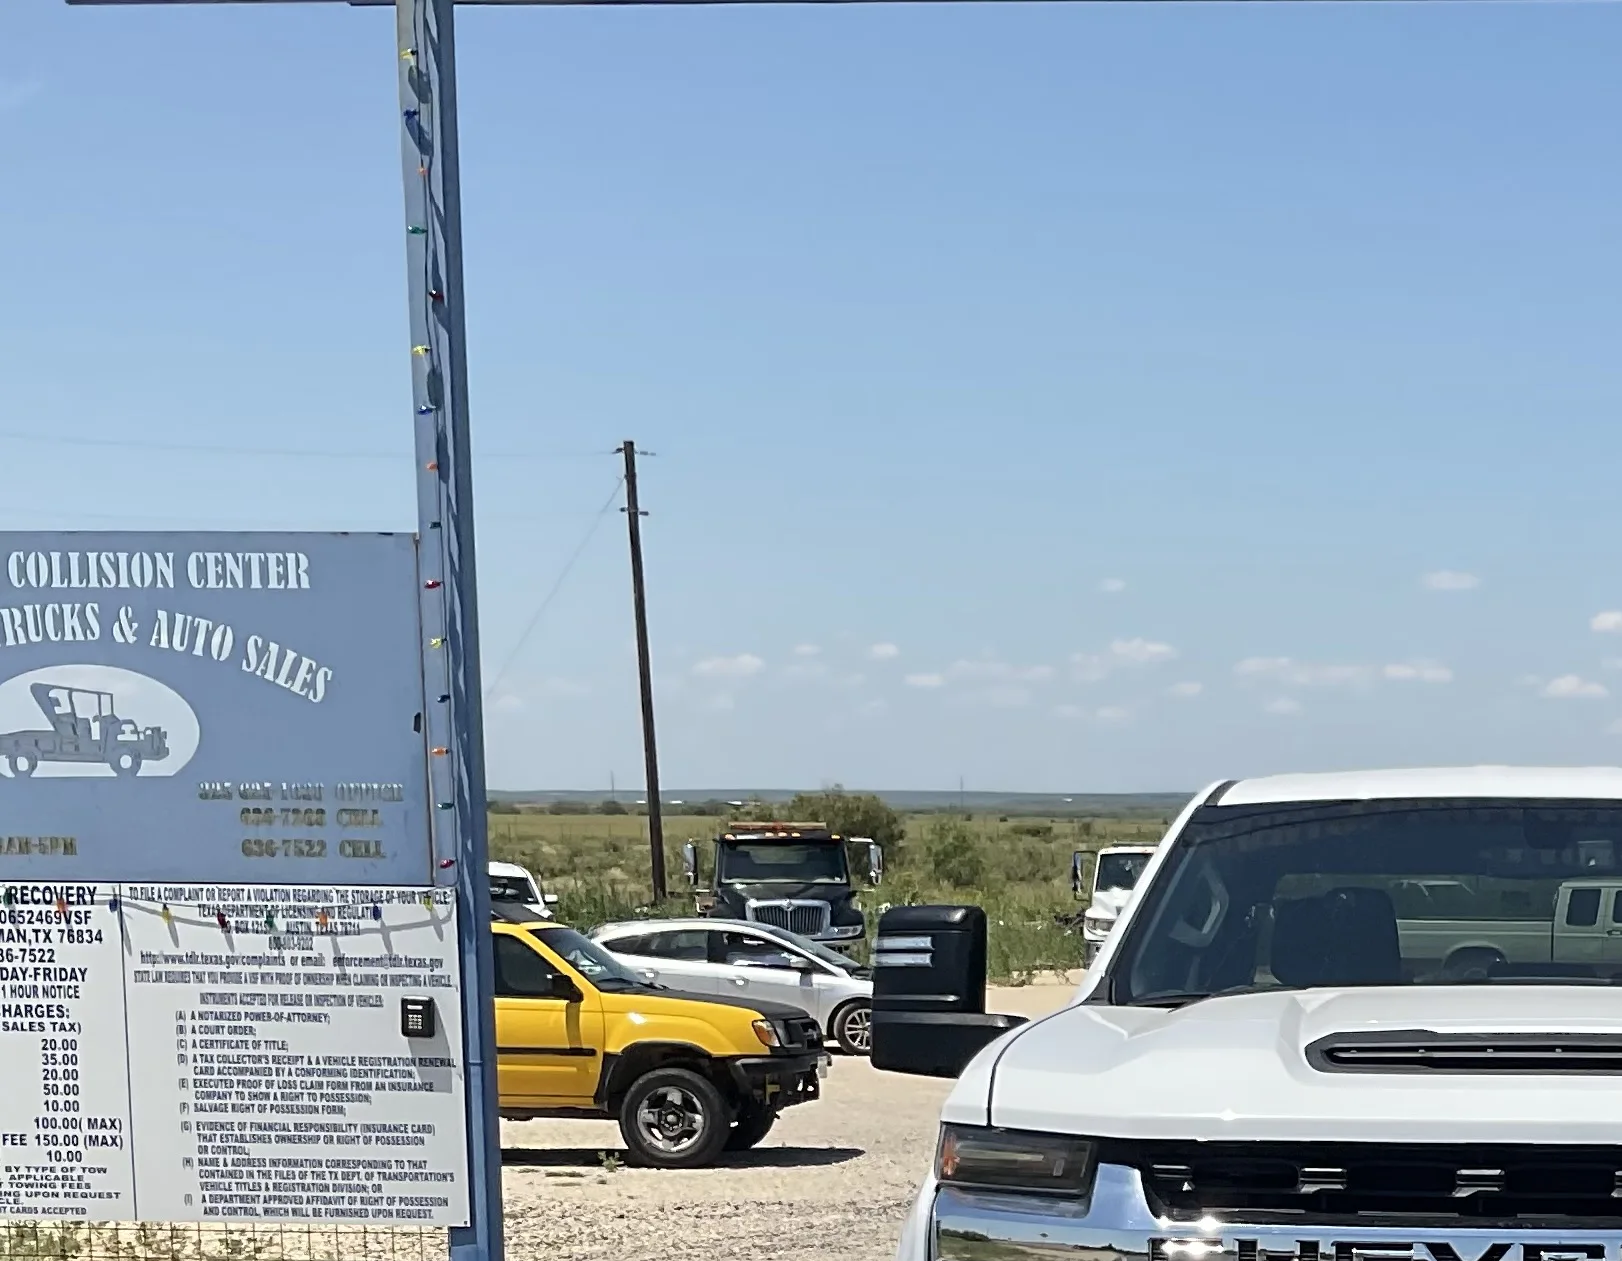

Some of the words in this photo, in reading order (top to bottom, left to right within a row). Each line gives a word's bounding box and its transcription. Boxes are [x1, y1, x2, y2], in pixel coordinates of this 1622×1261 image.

[8, 551, 174, 588] COLLISION
[187, 552, 310, 589] CENTER
[0, 602, 100, 646] RUCKS
[112, 606, 138, 644] &
[150, 609, 234, 661] AUTO
[241, 635, 333, 703] SALES
[9, 886, 97, 905] RECOVERY
[57, 929, 103, 944] 76834
[1, 967, 88, 982] DAY-FRIDAY
[10, 985, 39, 998] HOUR
[42, 985, 80, 999] NOTICE
[0, 1004, 70, 1019] HARGES:
[2, 1021, 45, 1032] SALES
[50, 1022, 82, 1034] TAX)
[41, 1039, 78, 1051] 20.00
[42, 1054, 78, 1066] 35.00
[43, 1069, 79, 1081] 20.00
[43, 1084, 79, 1096] 50.00
[44, 1100, 80, 1112] 10.00
[195, 1121, 235, 1132] EVIDENCE
[249, 1122, 290, 1132] FINANCIAL
[293, 1122, 357, 1133] RESPONSIBILITY
[2, 1134, 27, 1146] FEE
[35, 1134, 79, 1147] 150.00
[84, 1135, 123, 1150] (MAX)
[46, 1151, 82, 1162] 10.00
[41, 1207, 87, 1215] ACCEPTED
